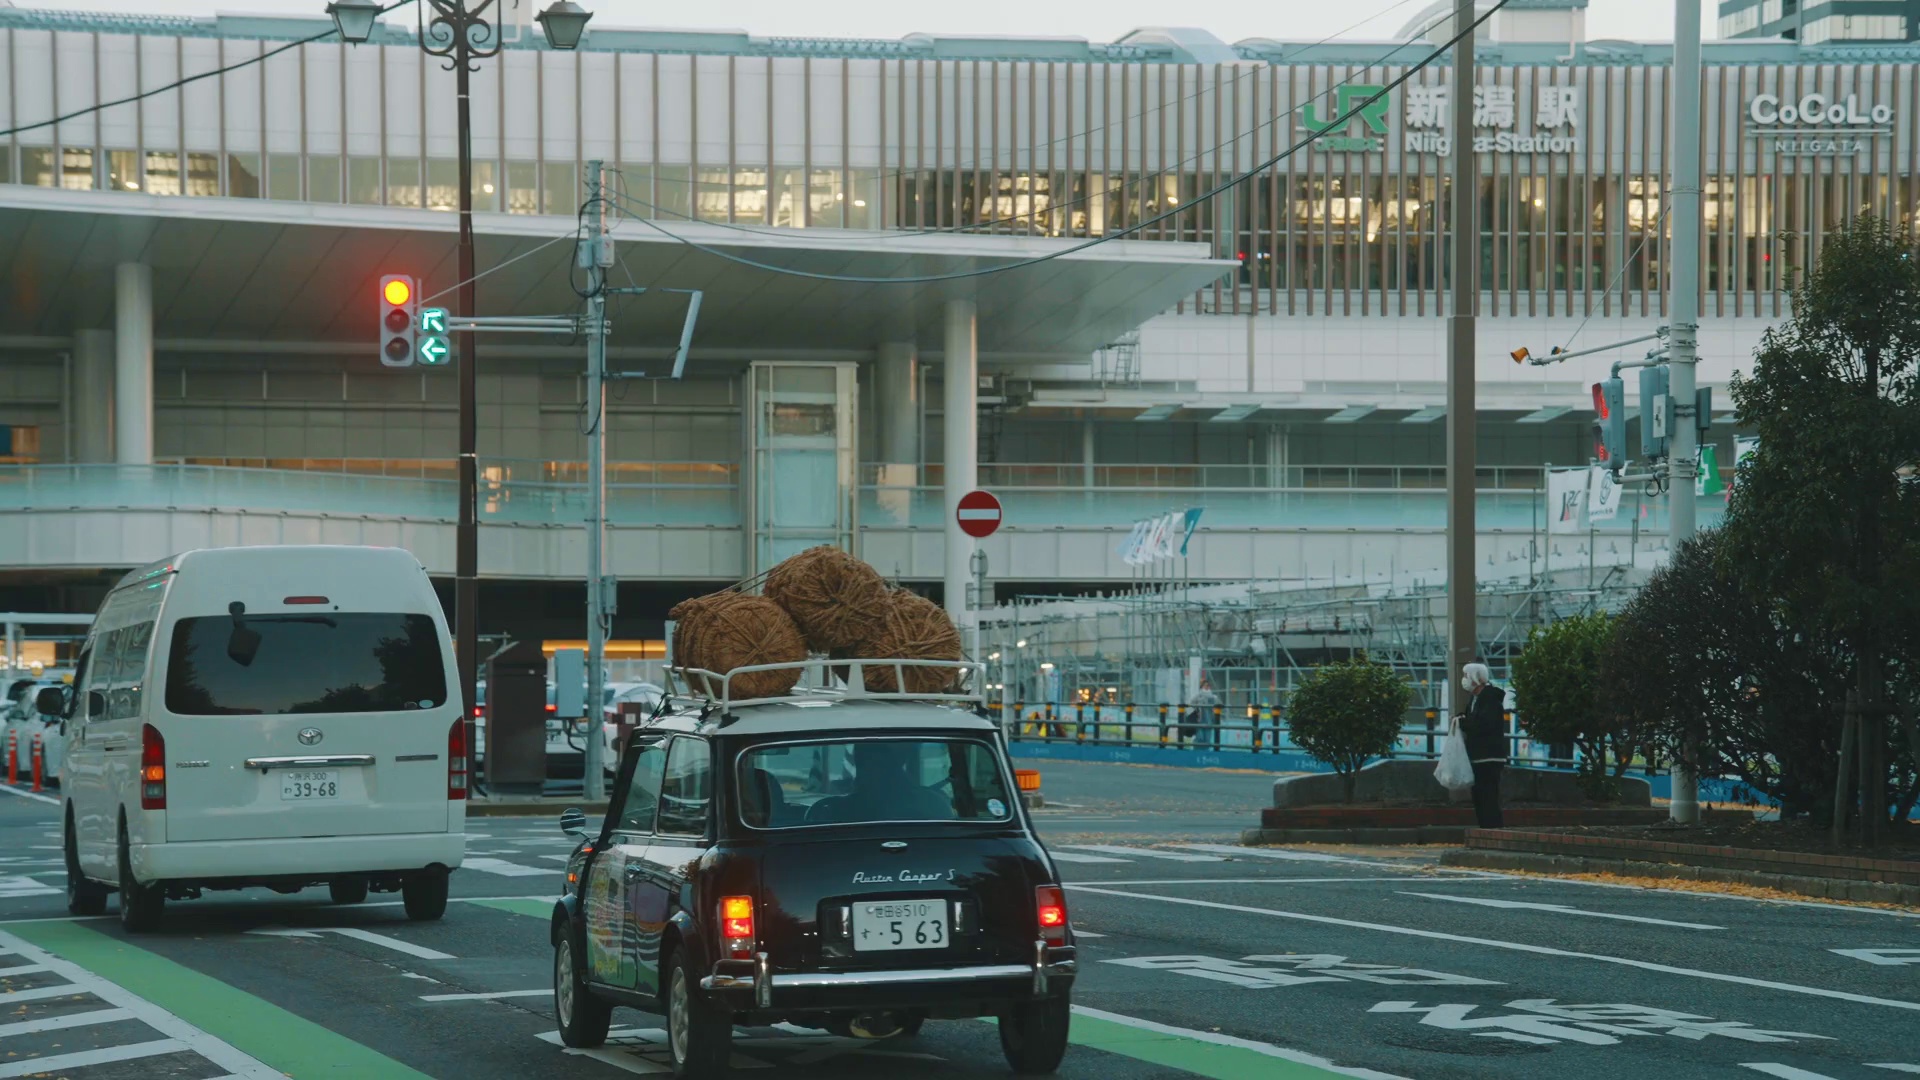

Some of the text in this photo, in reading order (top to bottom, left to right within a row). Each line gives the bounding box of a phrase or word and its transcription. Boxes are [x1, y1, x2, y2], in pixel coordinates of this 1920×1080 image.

[1303, 84, 1390, 135] JR
[1405, 85, 1579, 128] 新潟駅
[1750, 93, 1891, 124] CoCoLo
[1776, 140, 1864, 152] NIIGATA
[294, 782, 336, 797] 39-68
[852, 868, 956, 884] Austin Cooper S
